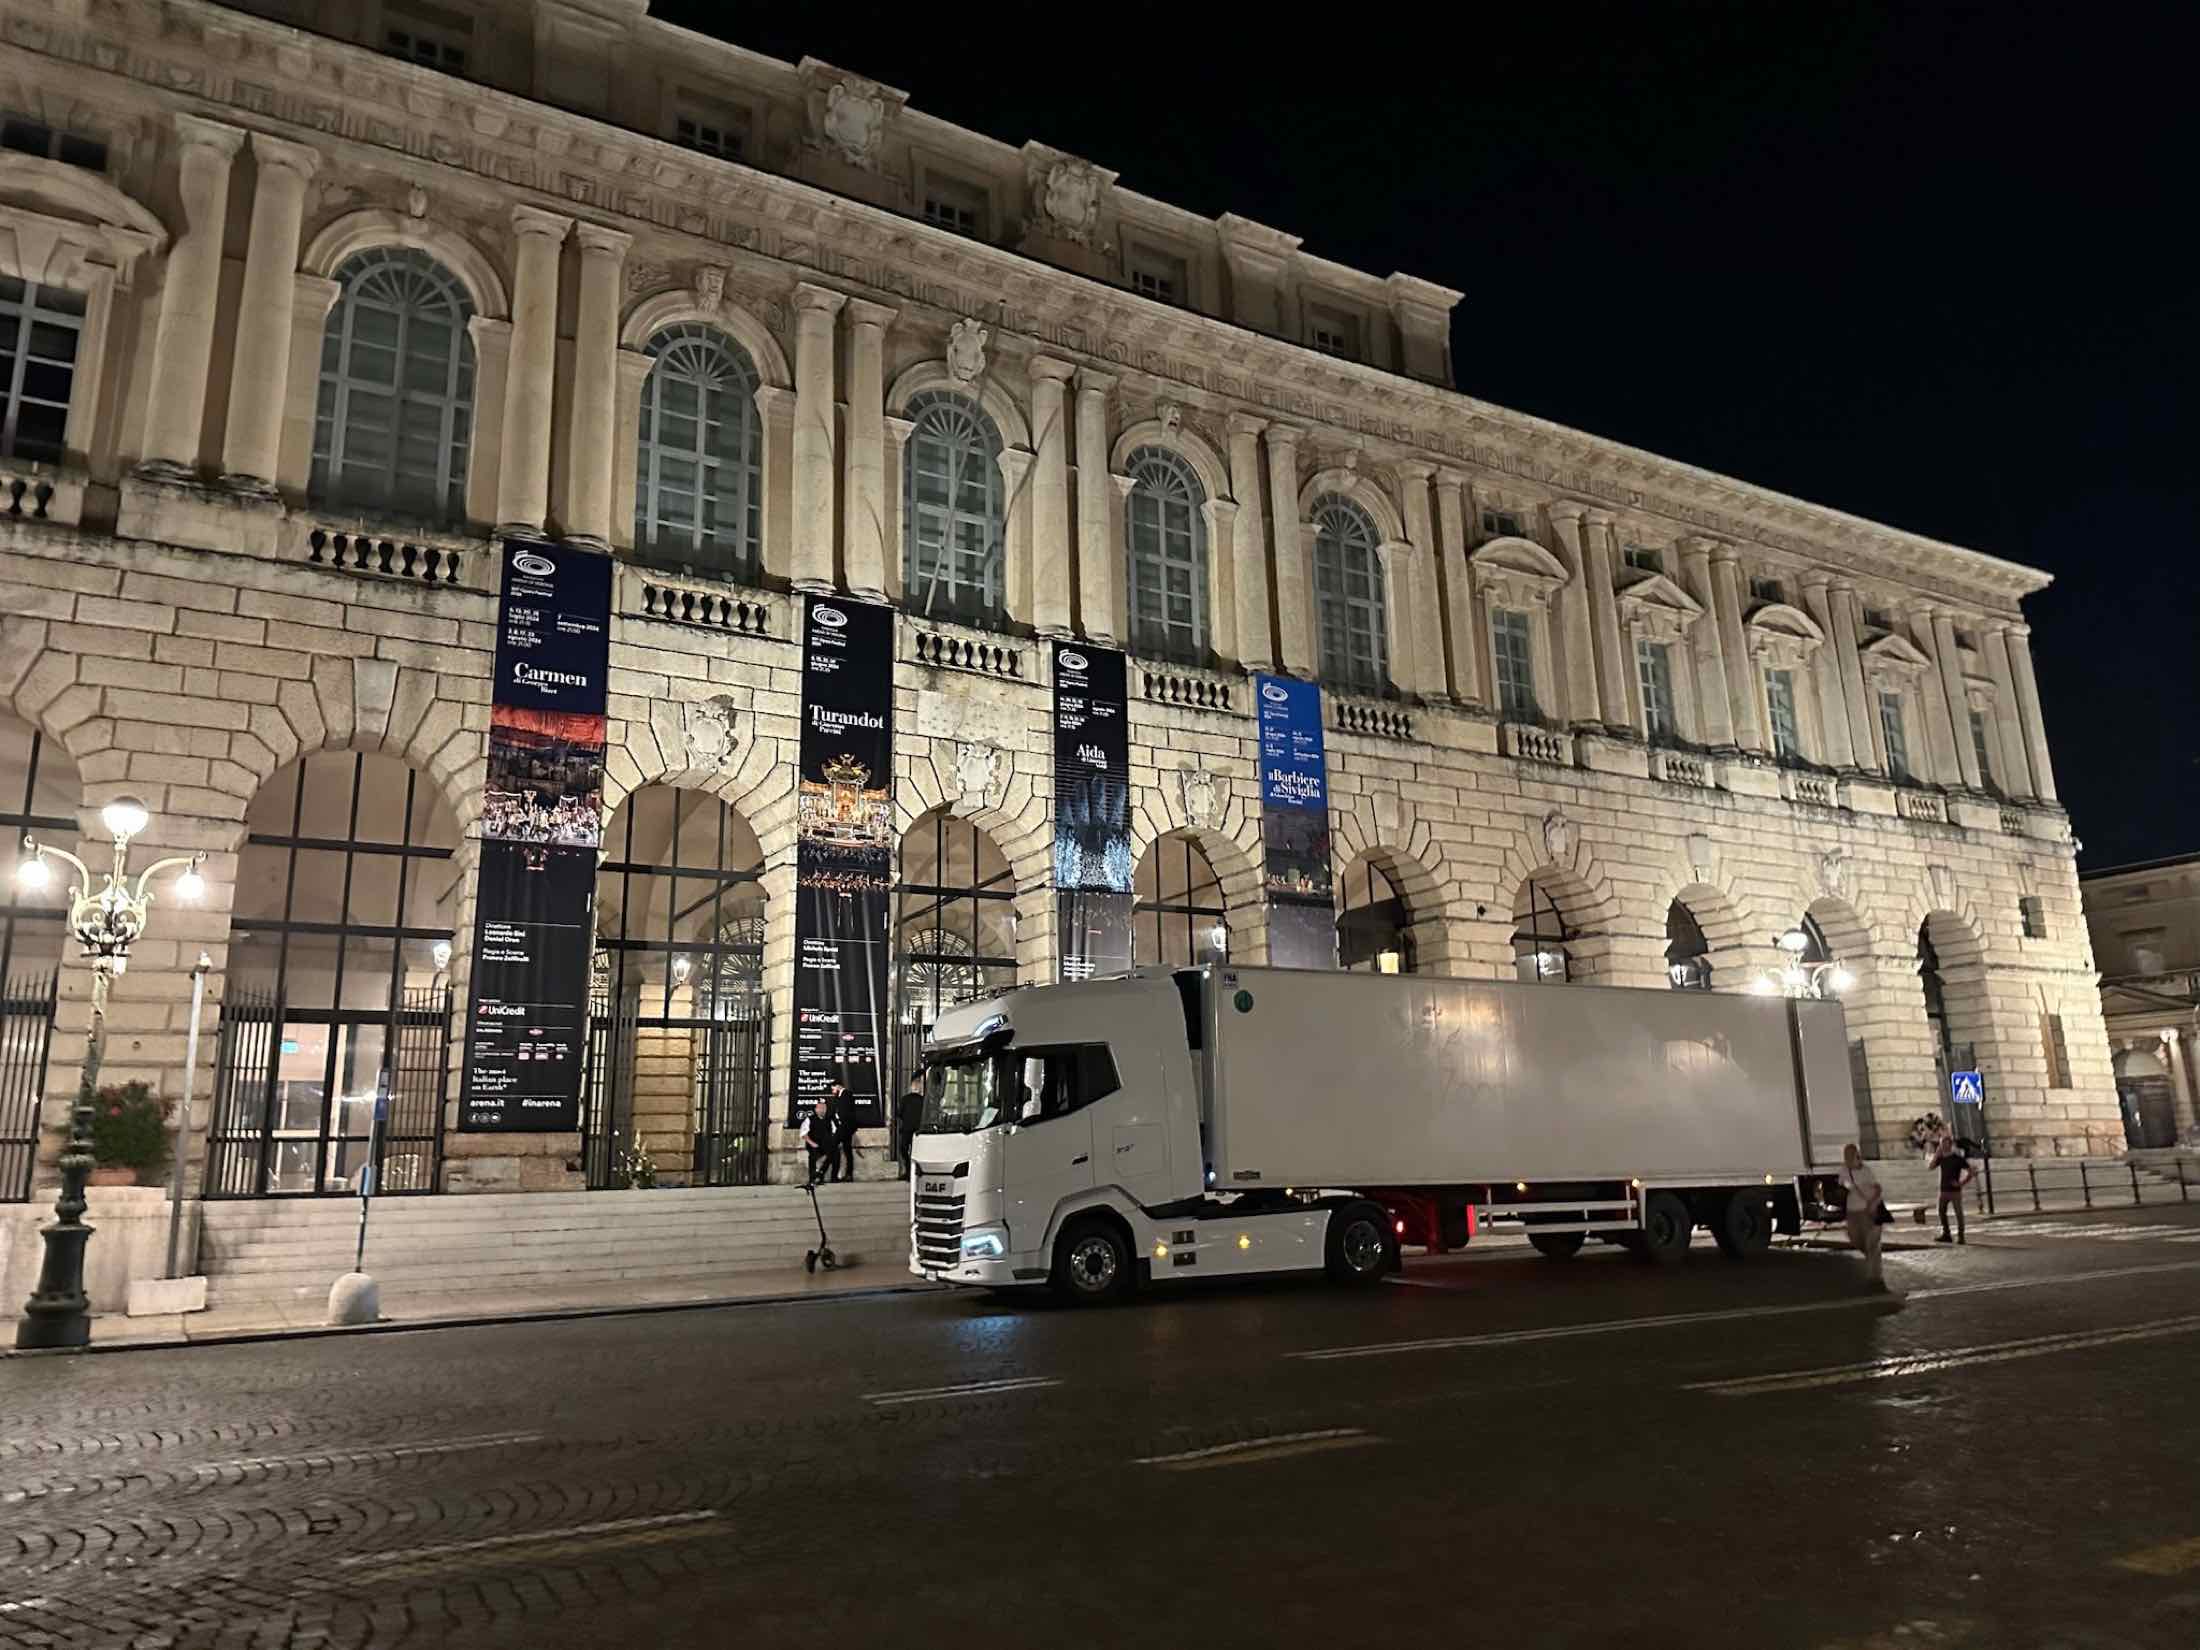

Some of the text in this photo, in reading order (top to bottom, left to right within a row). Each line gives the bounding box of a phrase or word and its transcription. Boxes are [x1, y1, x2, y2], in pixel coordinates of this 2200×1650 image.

[514, 662, 587, 687] Carmen
[809, 703, 884, 729] Turandot
[1076, 743, 1105, 760] Aida
[1273, 768, 1321, 786] Barbiere
[1280, 781, 1321, 800] Siviglia
[488, 1005, 525, 1016] UniCredit
[809, 1014, 840, 1024] UniCredit
[470, 1099, 505, 1108] arena.it
[522, 1098, 562, 1108] #inarena
[925, 1182, 946, 1193] DAF
